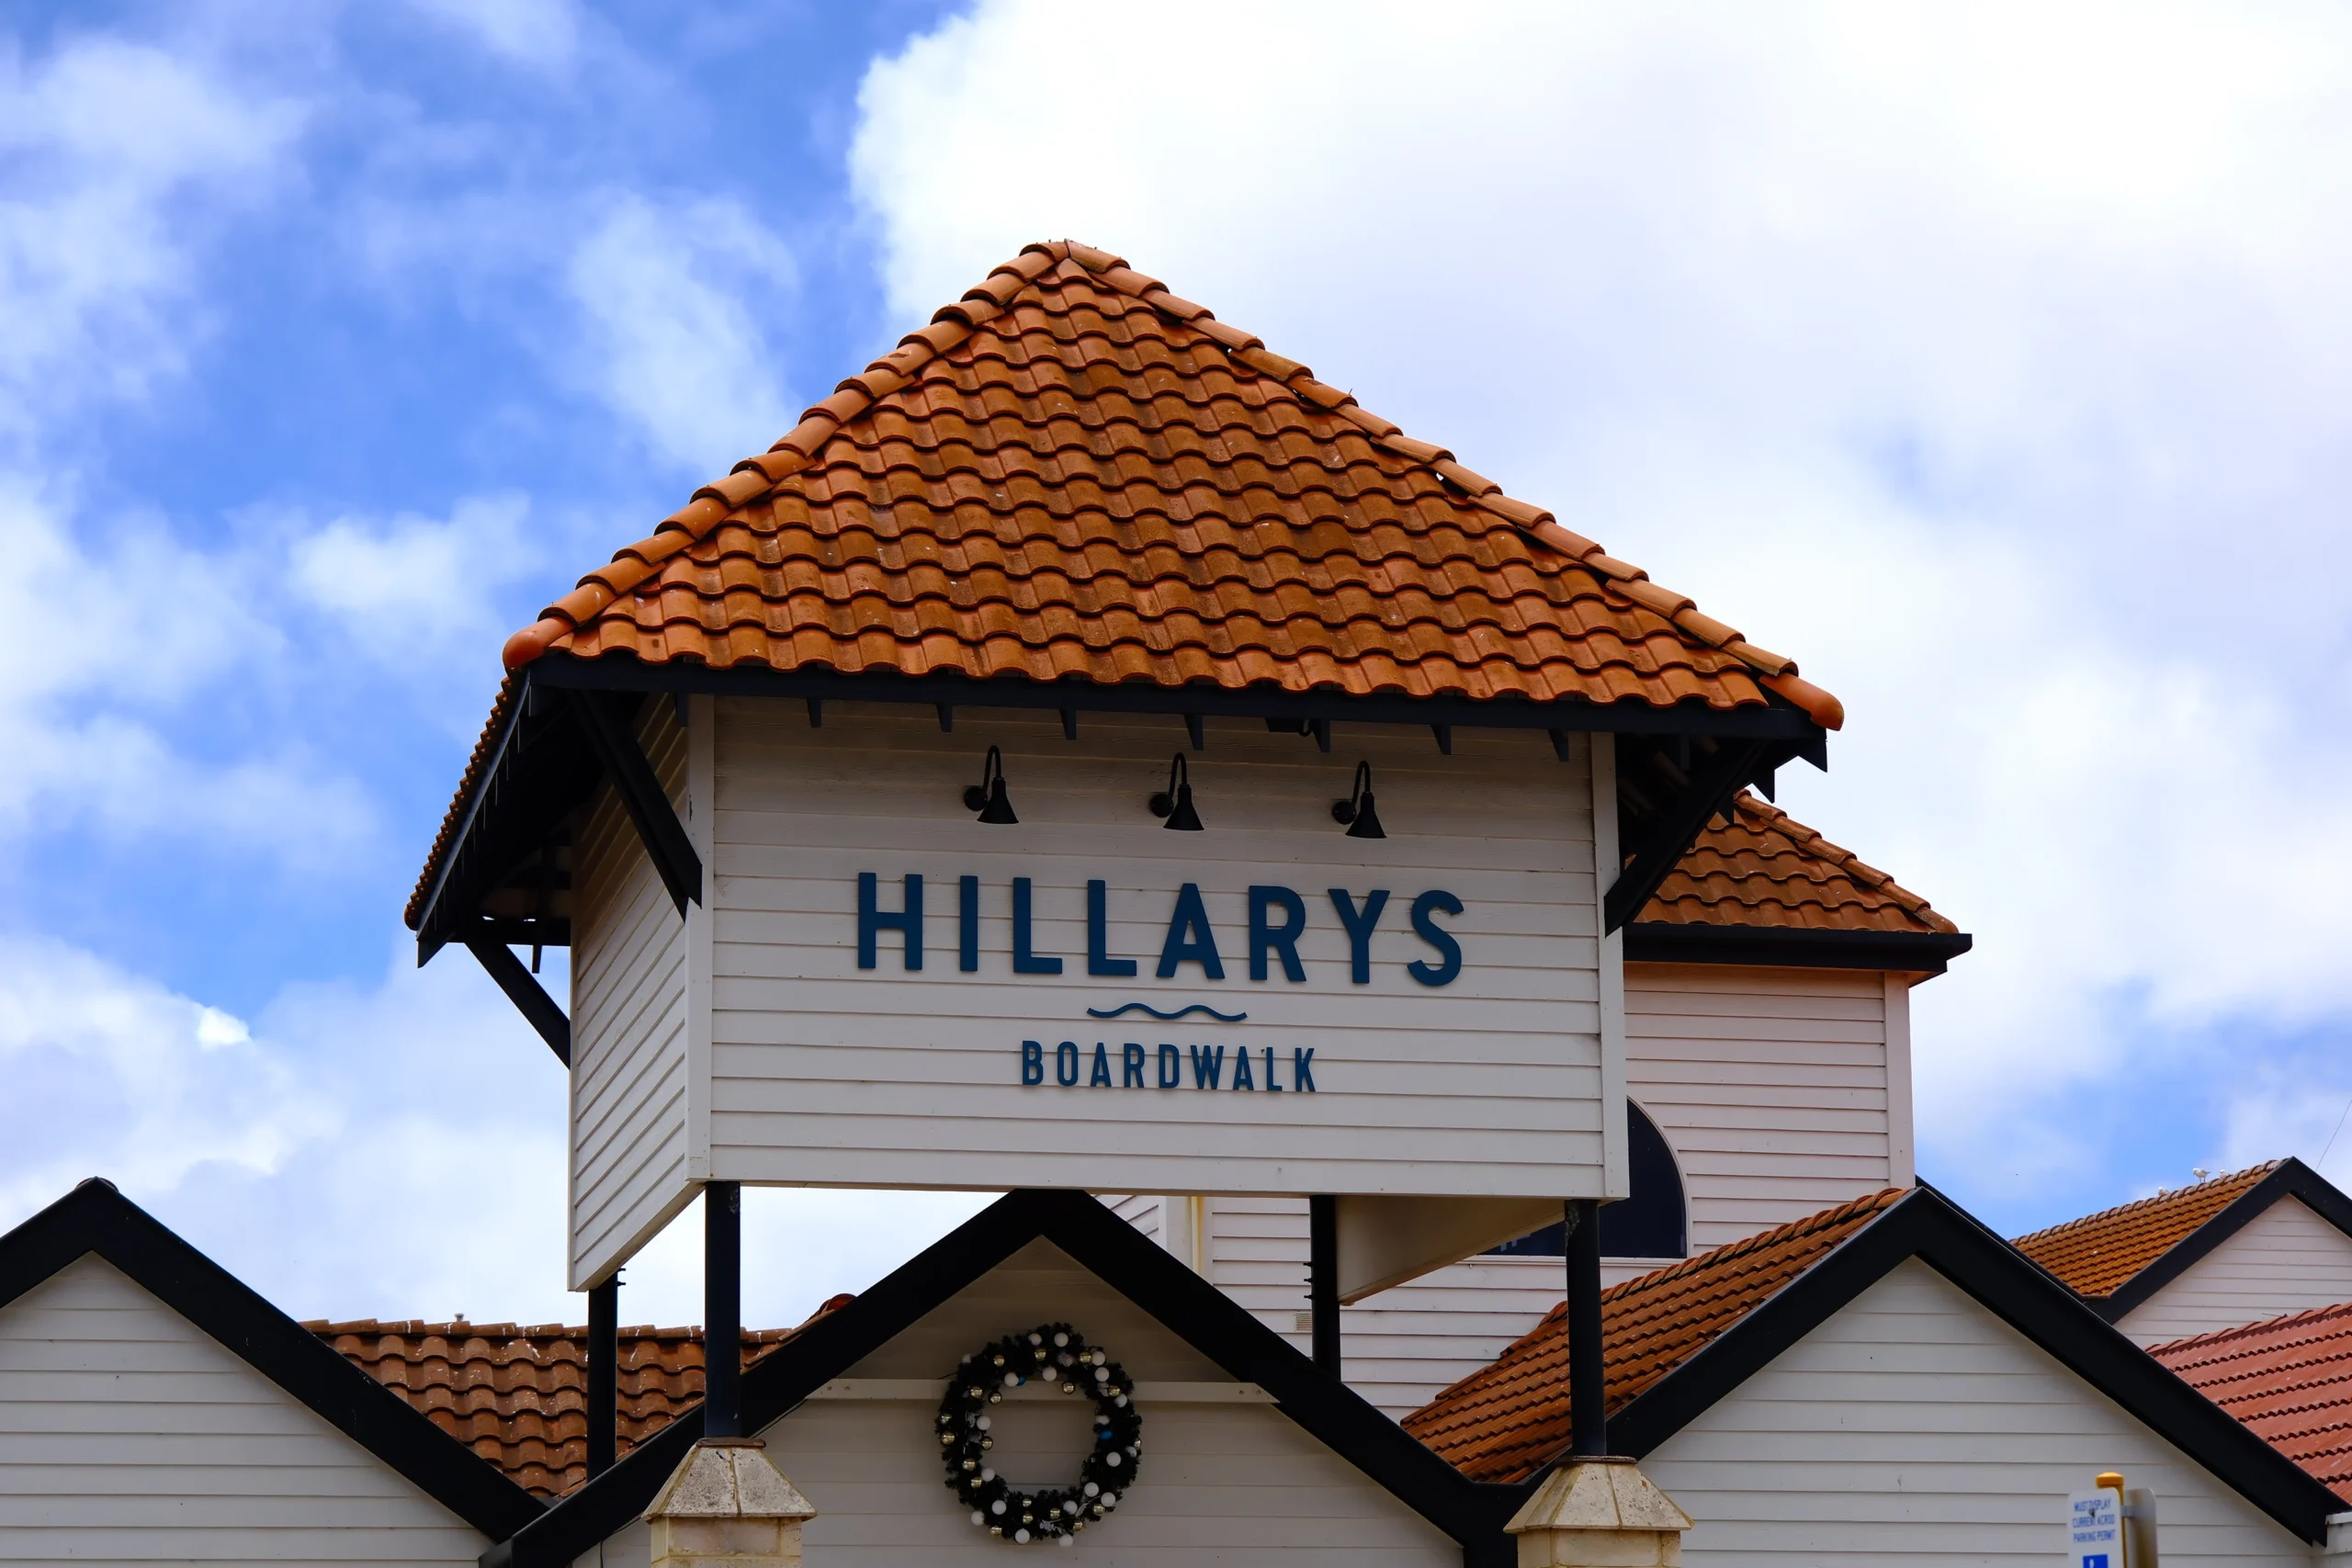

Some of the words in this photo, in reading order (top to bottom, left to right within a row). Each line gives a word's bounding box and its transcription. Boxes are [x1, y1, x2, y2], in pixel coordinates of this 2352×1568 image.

[857, 873, 1464, 987] HILLARYS
[1022, 1040, 1316, 1093] BOARDWALK
[2075, 1500, 2089, 1512] MUST
[2090, 1498, 2111, 1510] DISPLAY
[2073, 1517, 2096, 1528] CURRENT
[2074, 1531, 2096, 1543] PARKING
[2098, 1529, 2116, 1541] PERMIT
